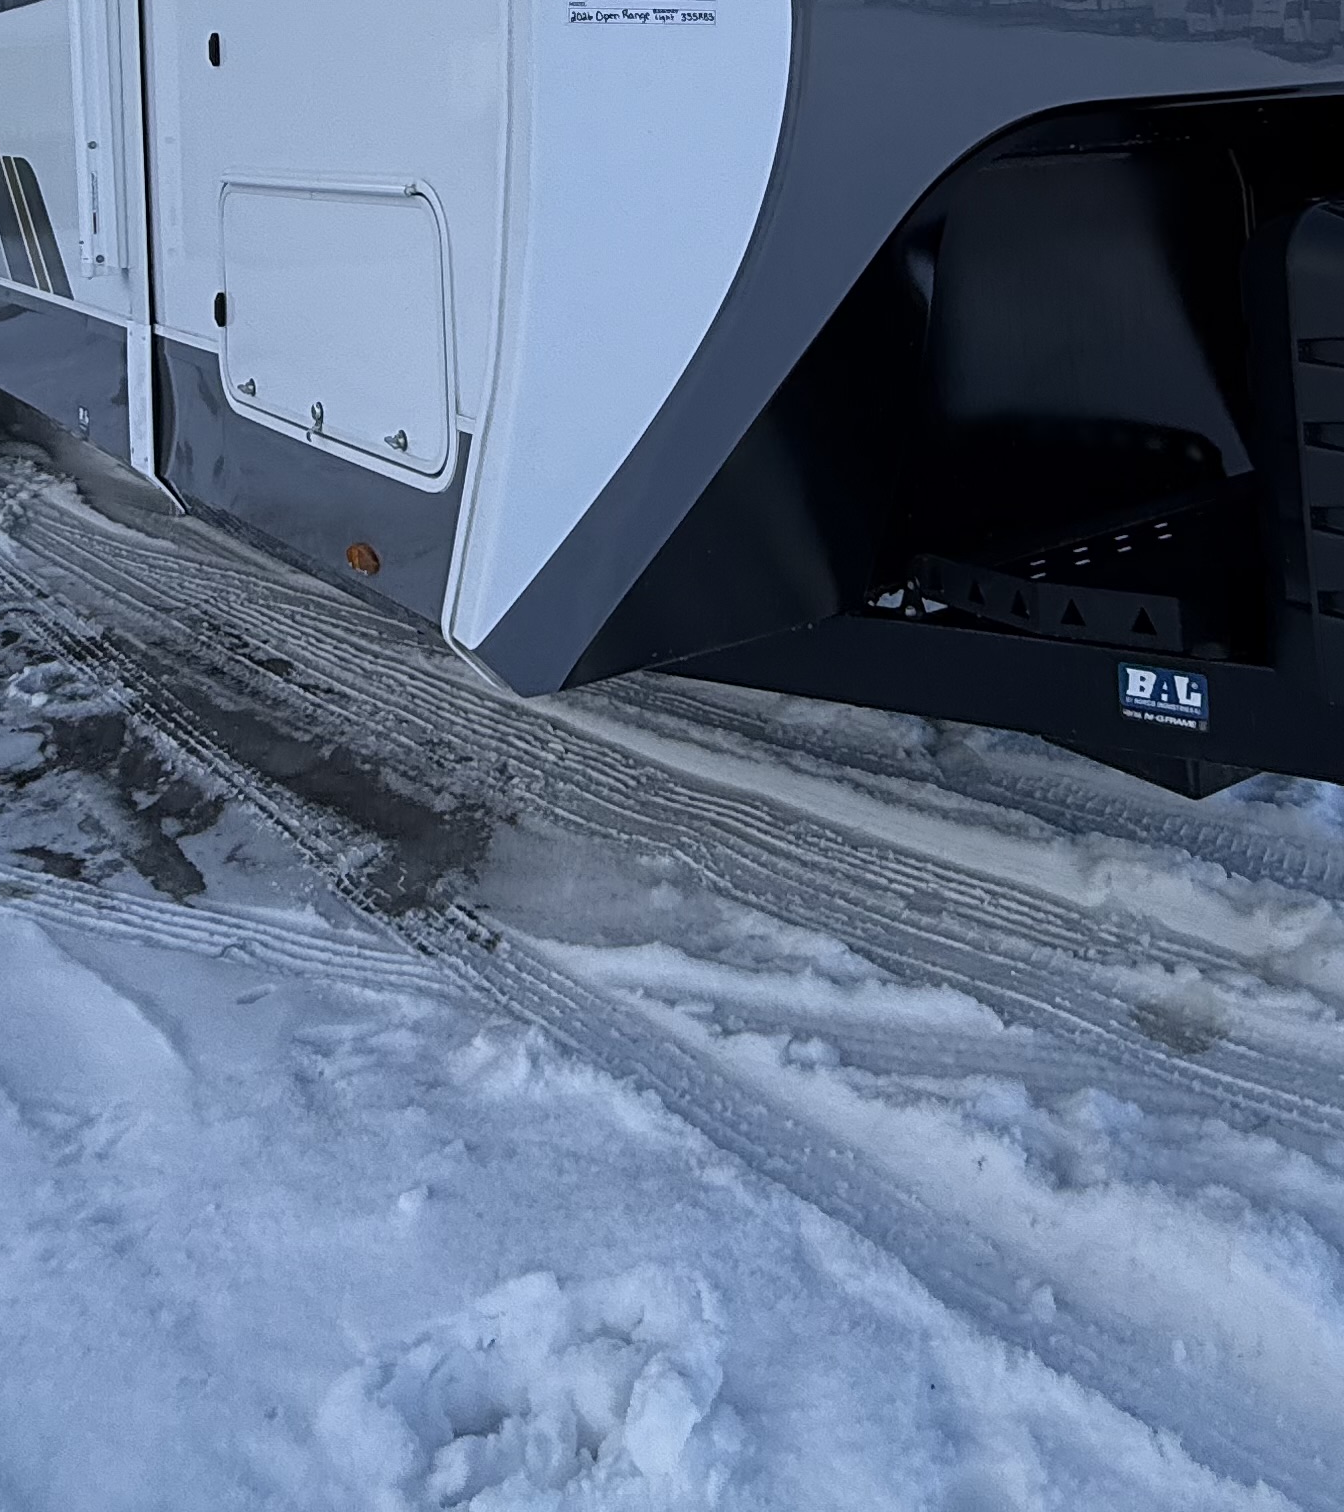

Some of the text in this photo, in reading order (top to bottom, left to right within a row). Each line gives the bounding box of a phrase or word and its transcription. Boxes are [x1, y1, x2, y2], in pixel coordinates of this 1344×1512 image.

[570, 11, 593, 23] 2026
[596, 10, 620, 24] Open
[622, 8, 650, 24] Range
[1126, 668, 1202, 707] BAL
